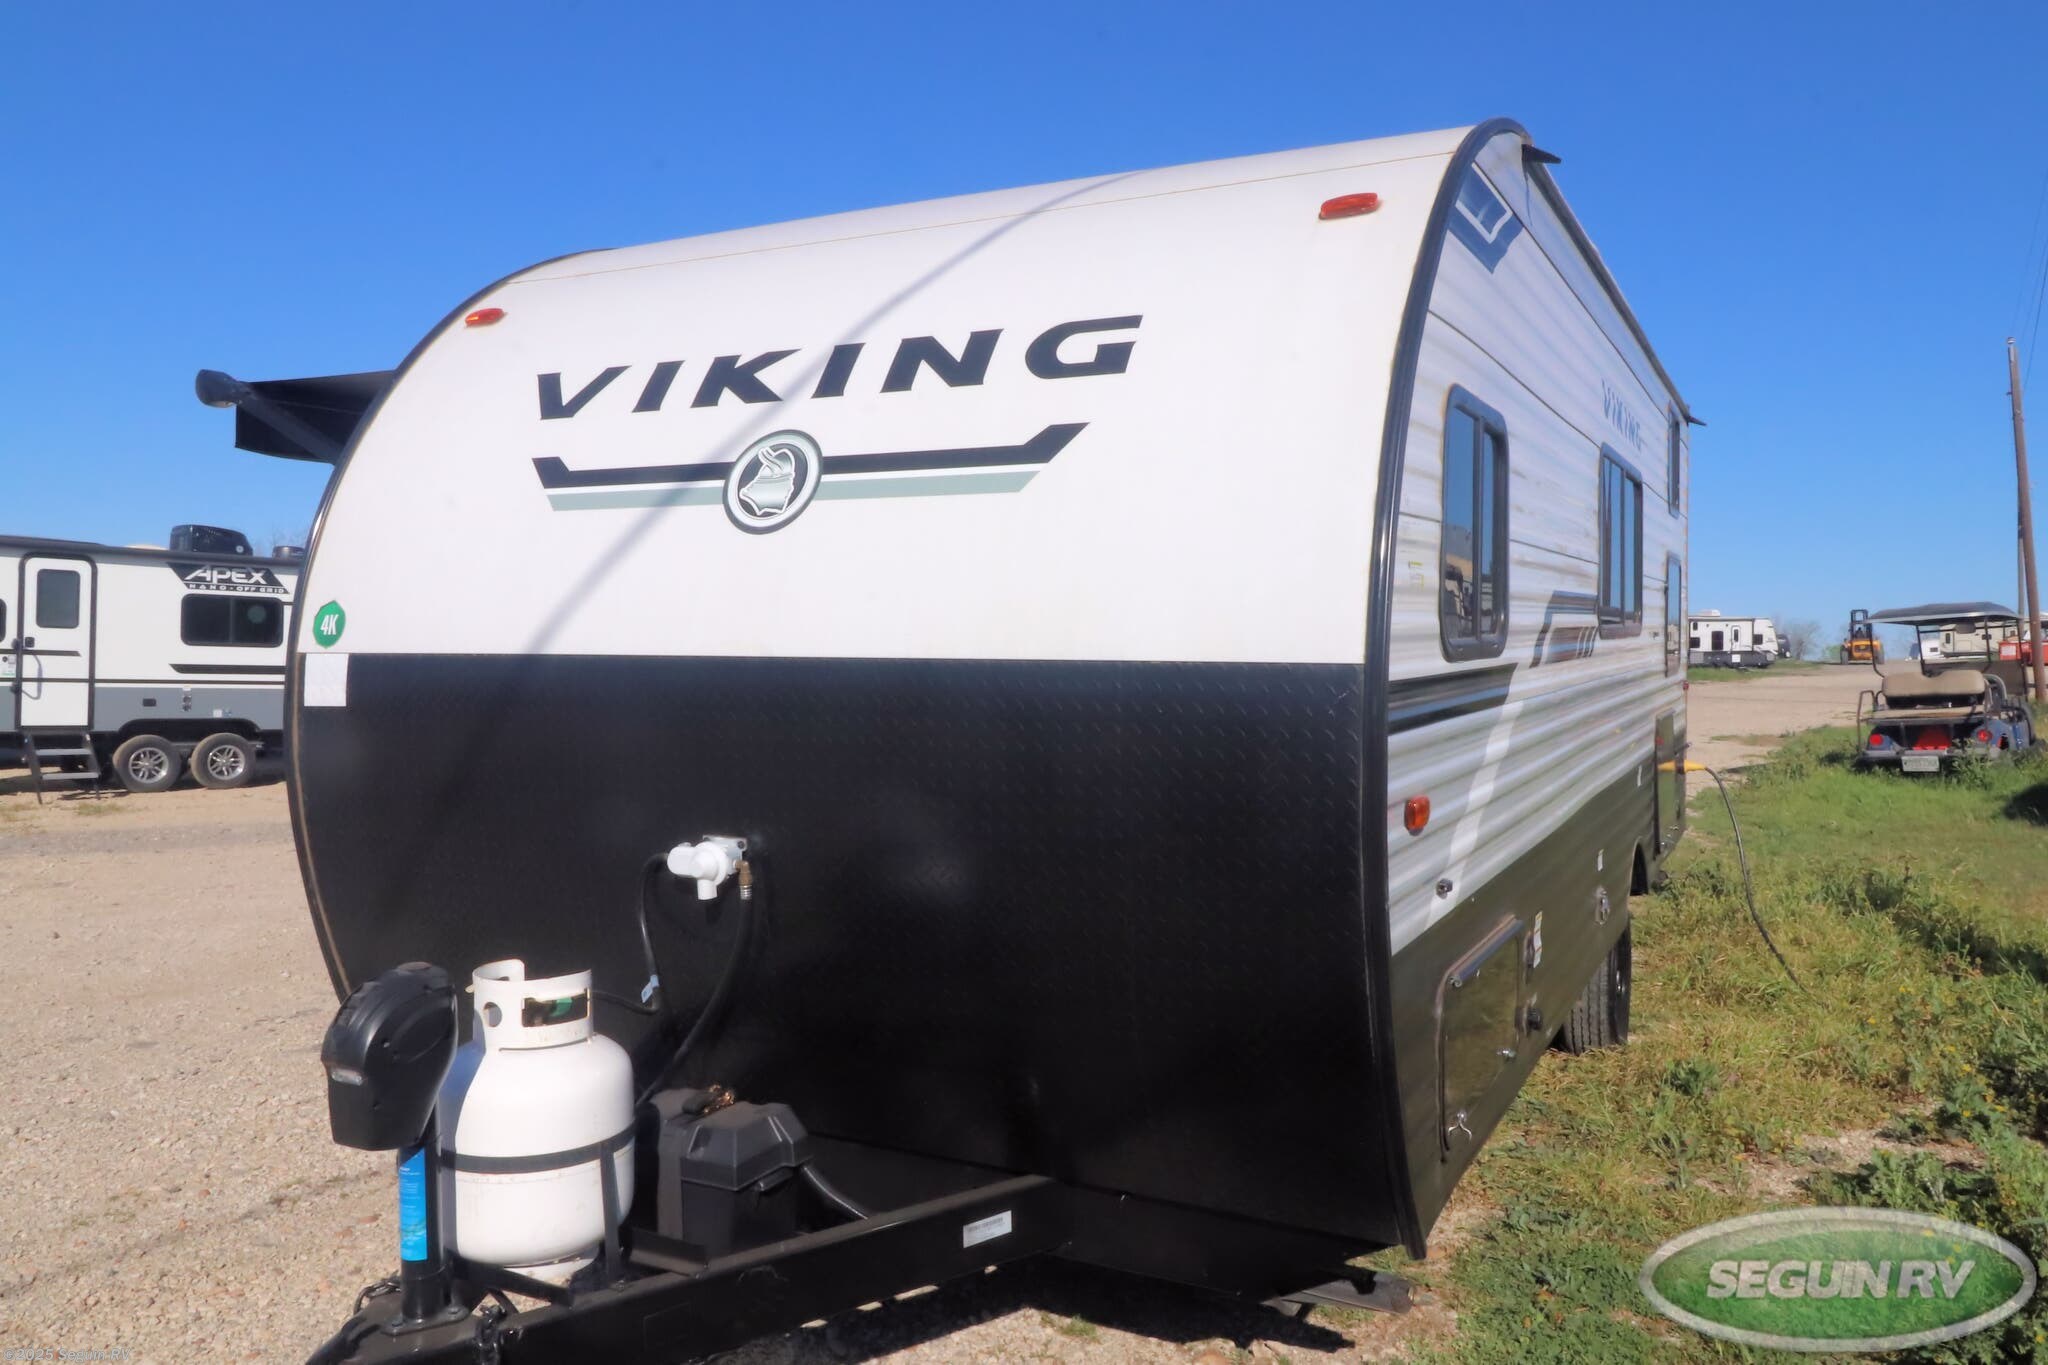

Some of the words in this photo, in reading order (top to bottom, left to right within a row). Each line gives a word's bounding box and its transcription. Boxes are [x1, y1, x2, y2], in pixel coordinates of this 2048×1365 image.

[537, 315, 1142, 420] VIKING
[1601, 378, 1642, 452] VIKING
[184, 565, 267, 584] APEX
[320, 614, 339, 635] 4K
